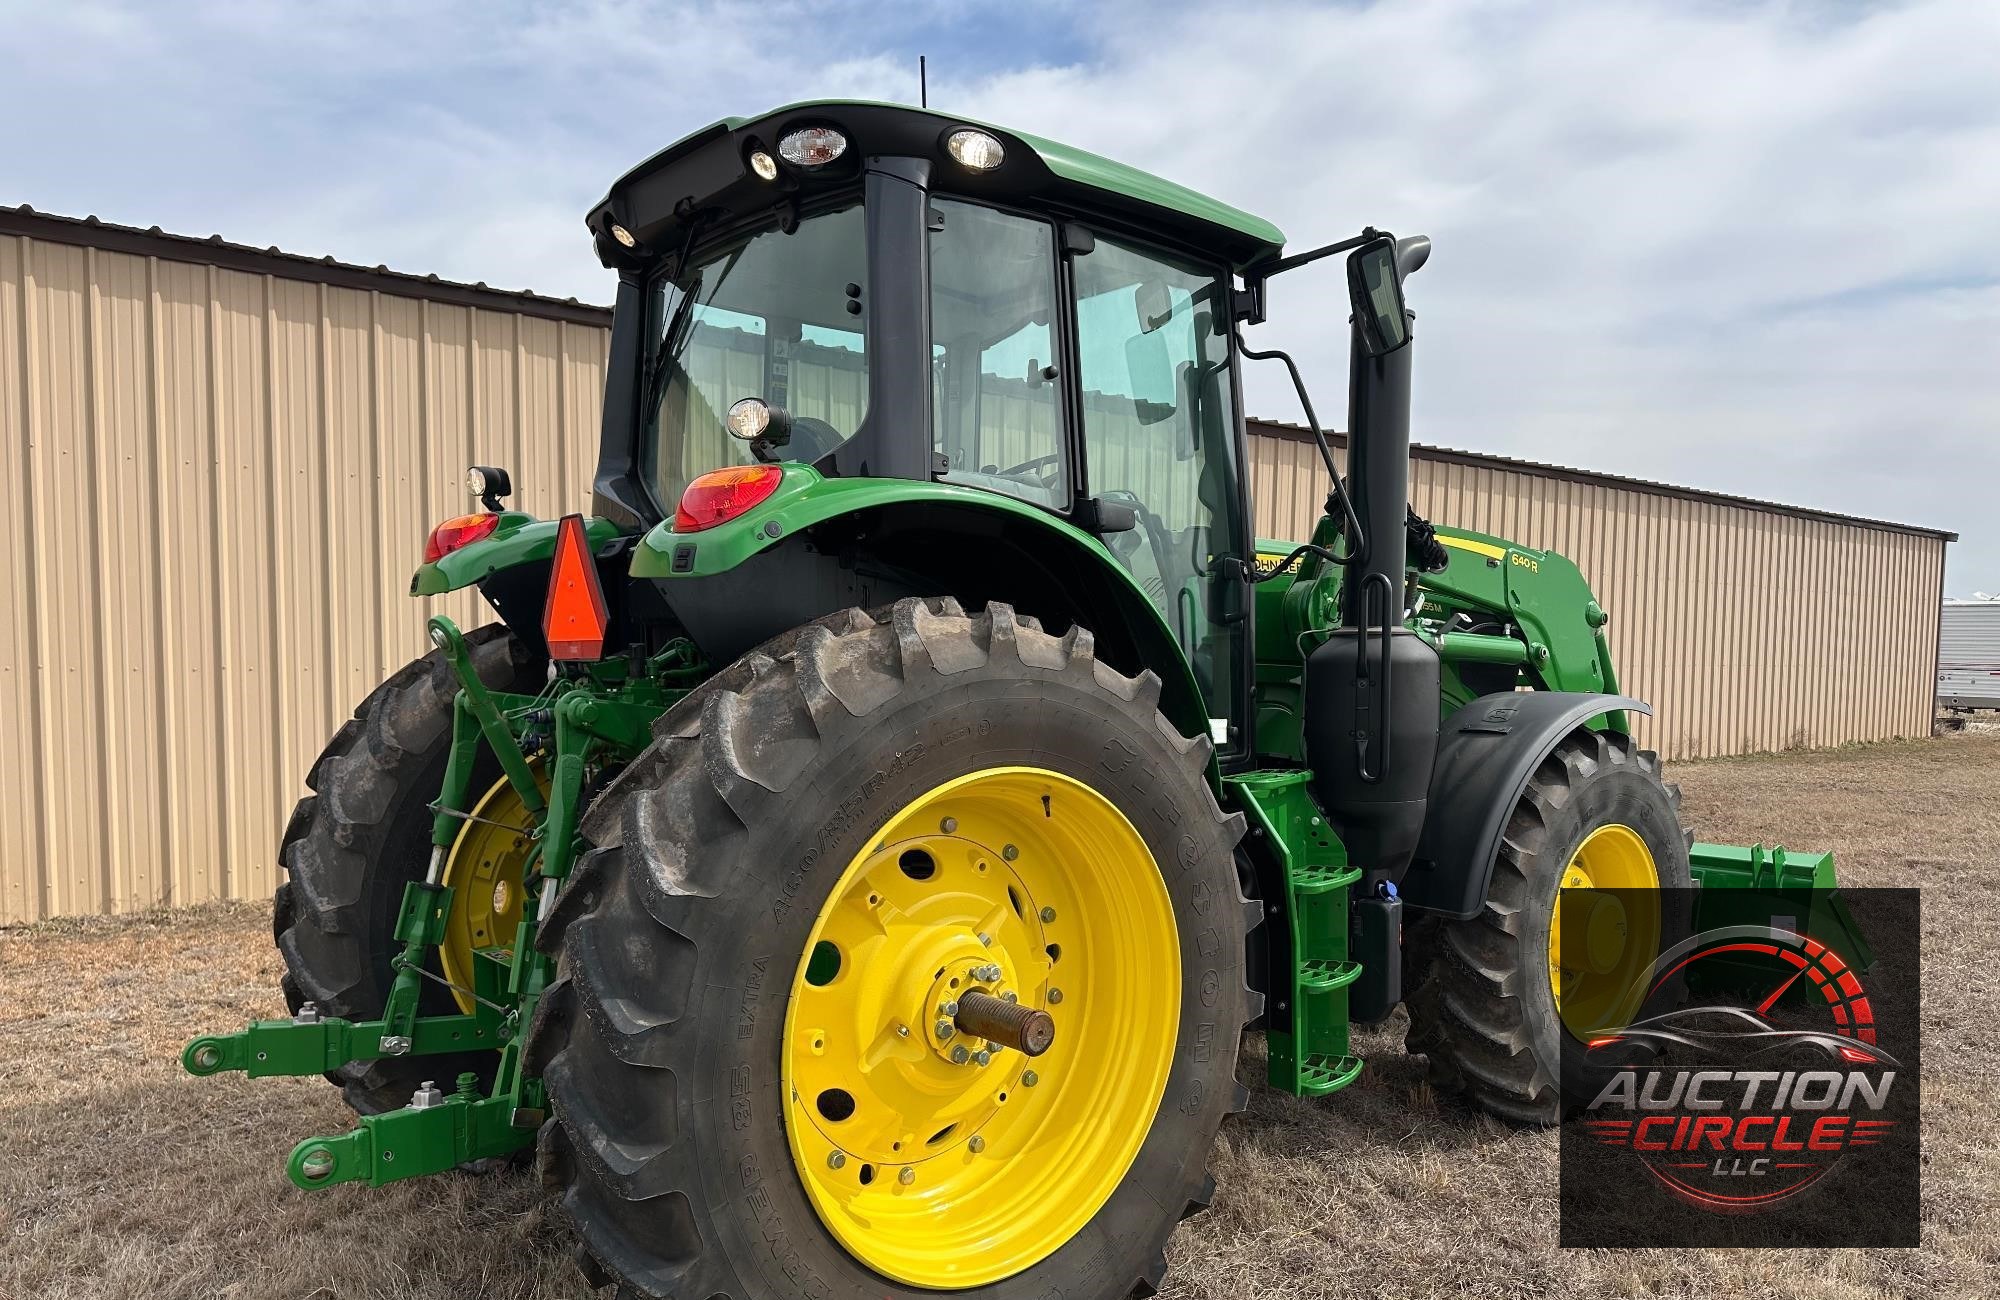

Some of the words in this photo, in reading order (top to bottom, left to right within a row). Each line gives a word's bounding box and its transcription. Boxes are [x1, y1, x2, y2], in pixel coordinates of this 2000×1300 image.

[1255, 559, 1278, 571] OHN
[737, 954, 772, 1041] EXTRA
[730, 1064, 753, 1132] 85
